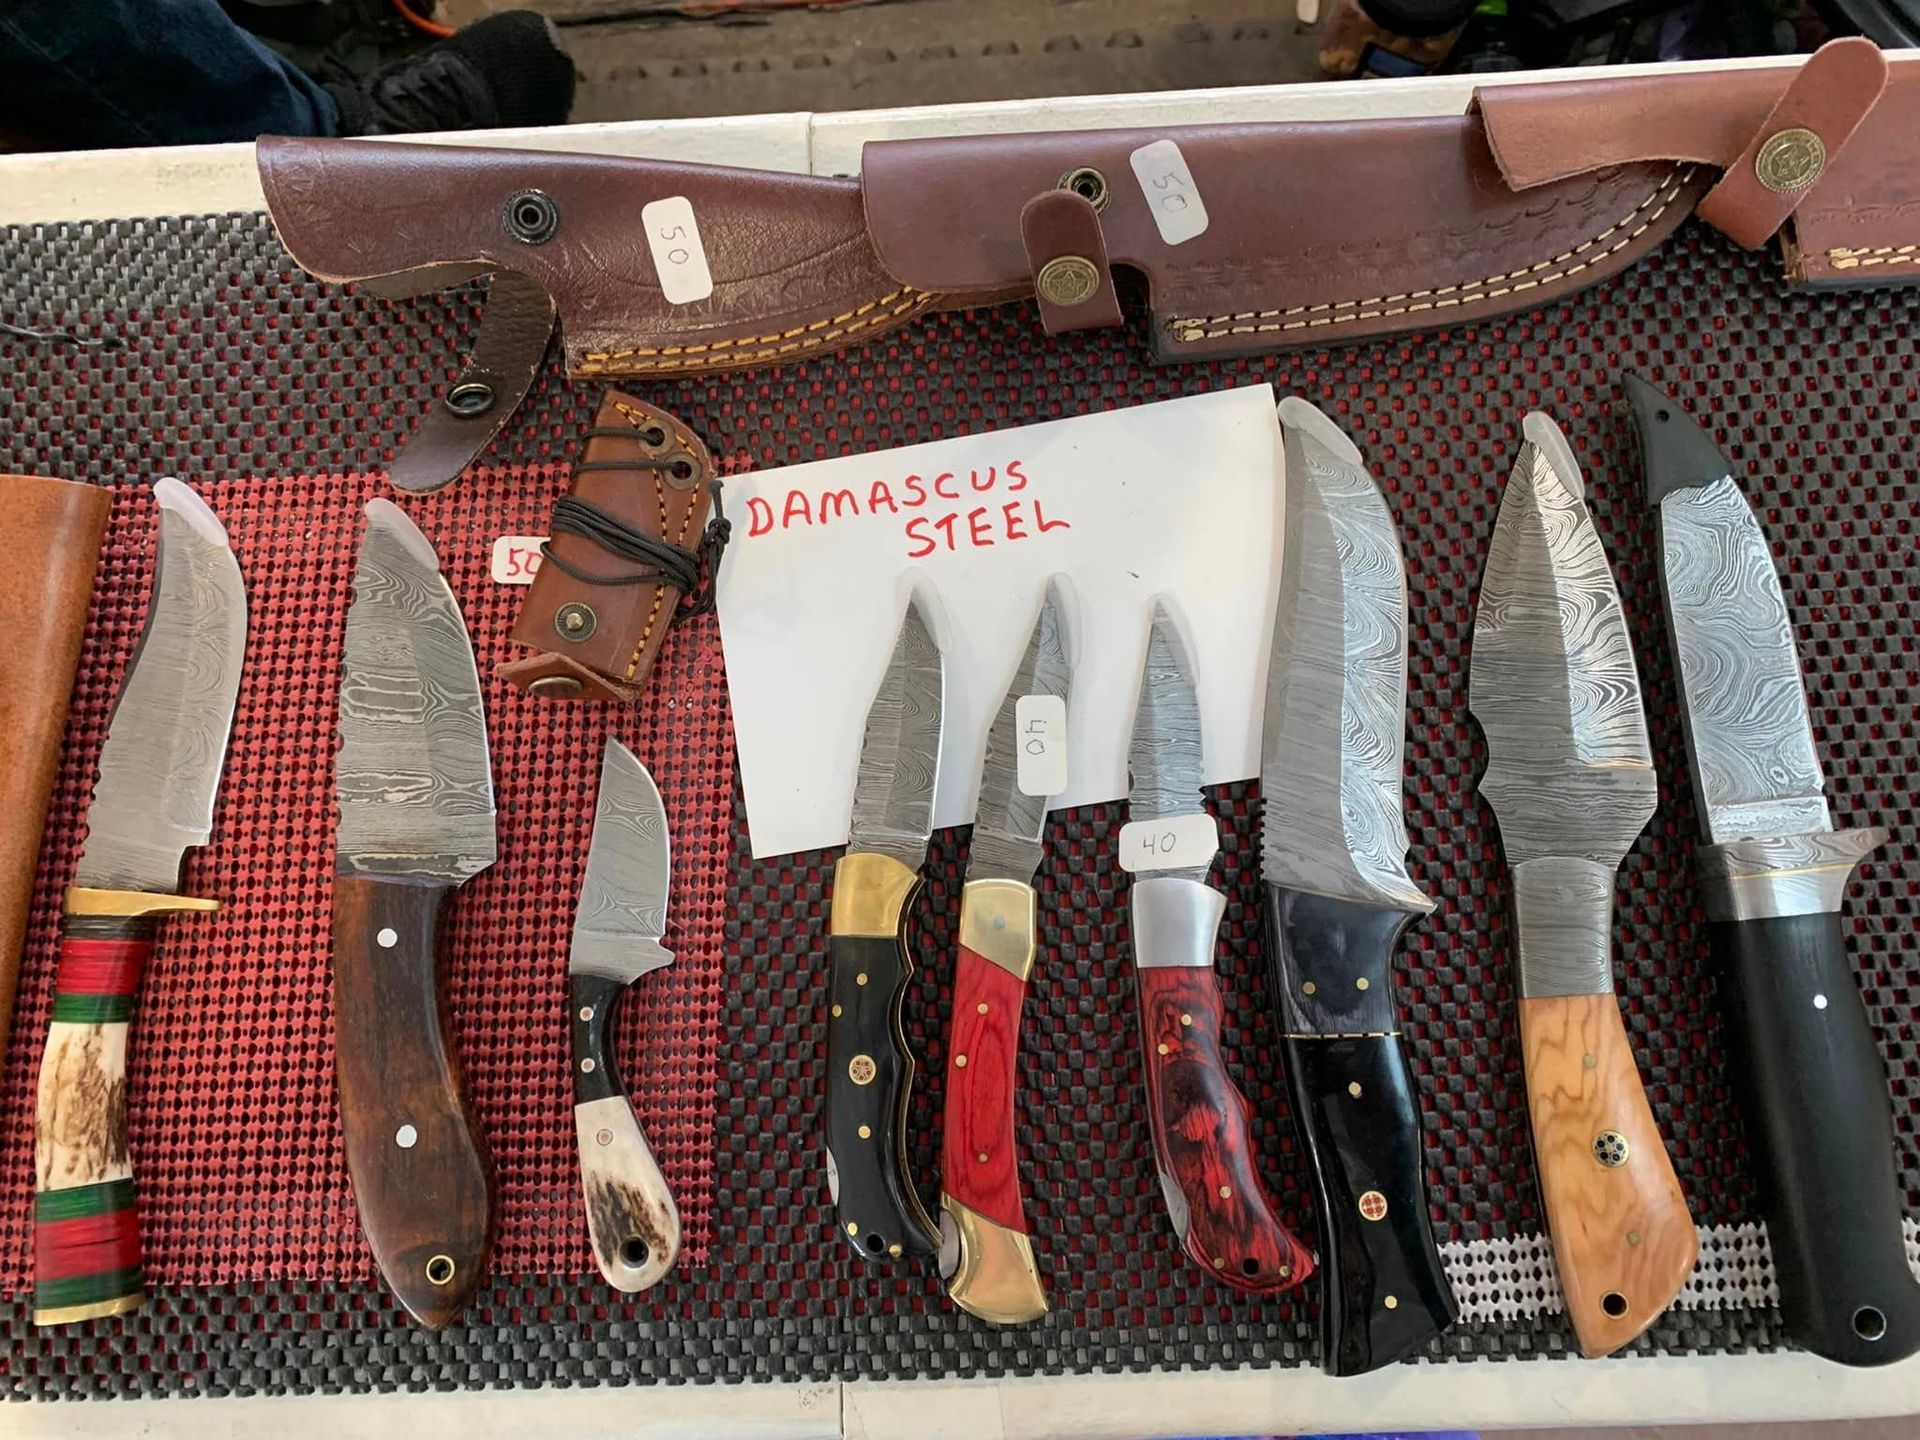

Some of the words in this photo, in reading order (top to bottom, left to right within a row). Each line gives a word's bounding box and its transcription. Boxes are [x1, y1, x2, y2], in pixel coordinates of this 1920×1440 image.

[1152, 171, 1188, 213] 50
[660, 225, 690, 265] 50
[746, 459, 1028, 538] DAMASCUS
[904, 499, 1071, 558] STEEL
[1142, 831, 1176, 856] 40
